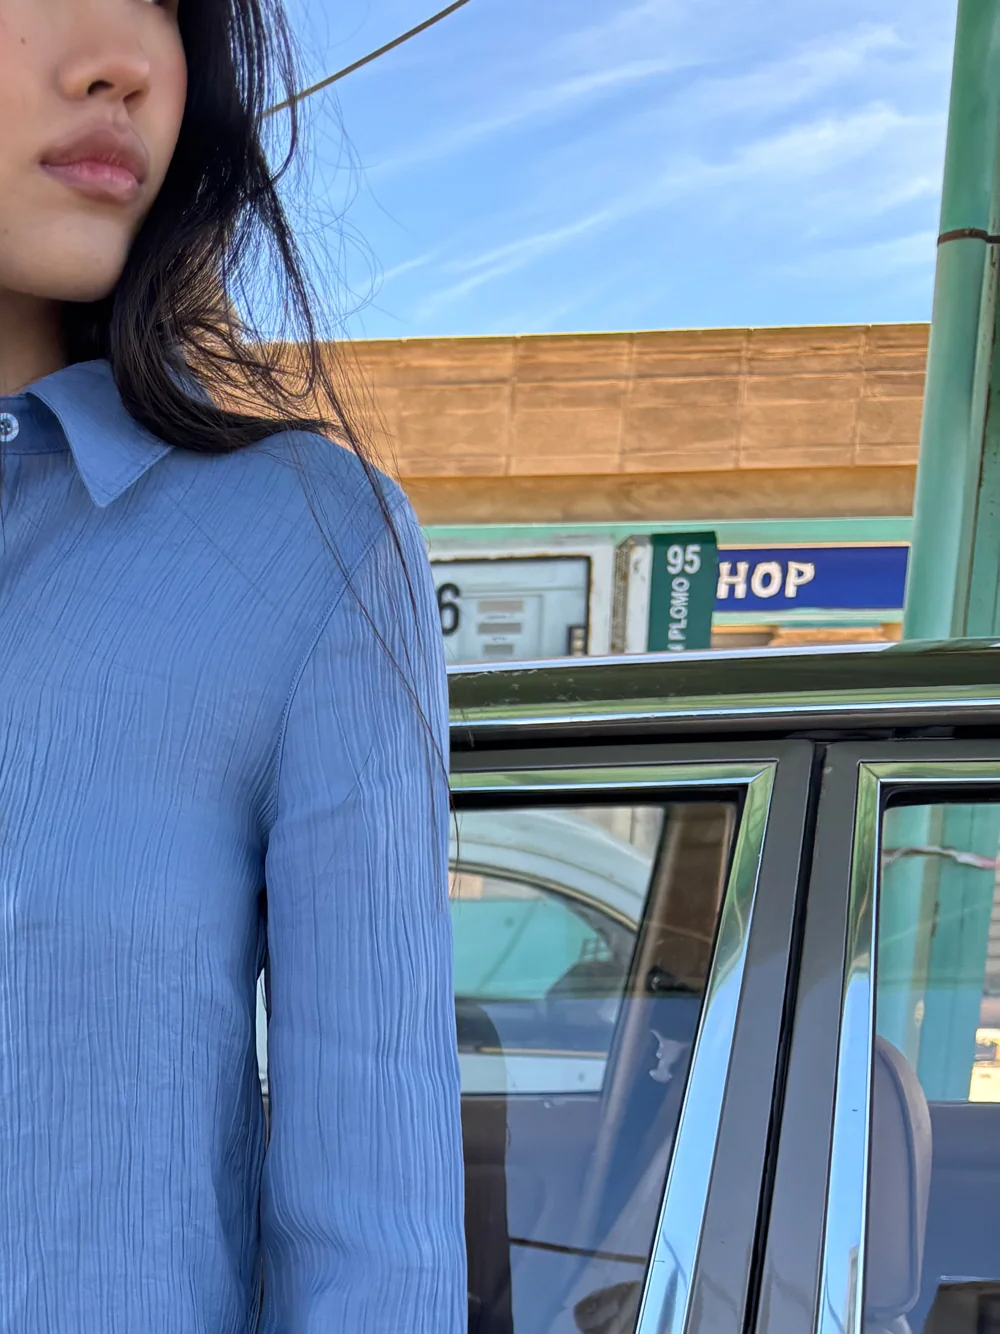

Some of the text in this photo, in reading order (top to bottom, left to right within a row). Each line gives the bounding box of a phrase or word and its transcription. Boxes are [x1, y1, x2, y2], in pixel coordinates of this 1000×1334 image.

[666, 544, 701, 575] 95
[716, 561, 815, 600] HOP
[667, 577, 690, 641] PLOMO
